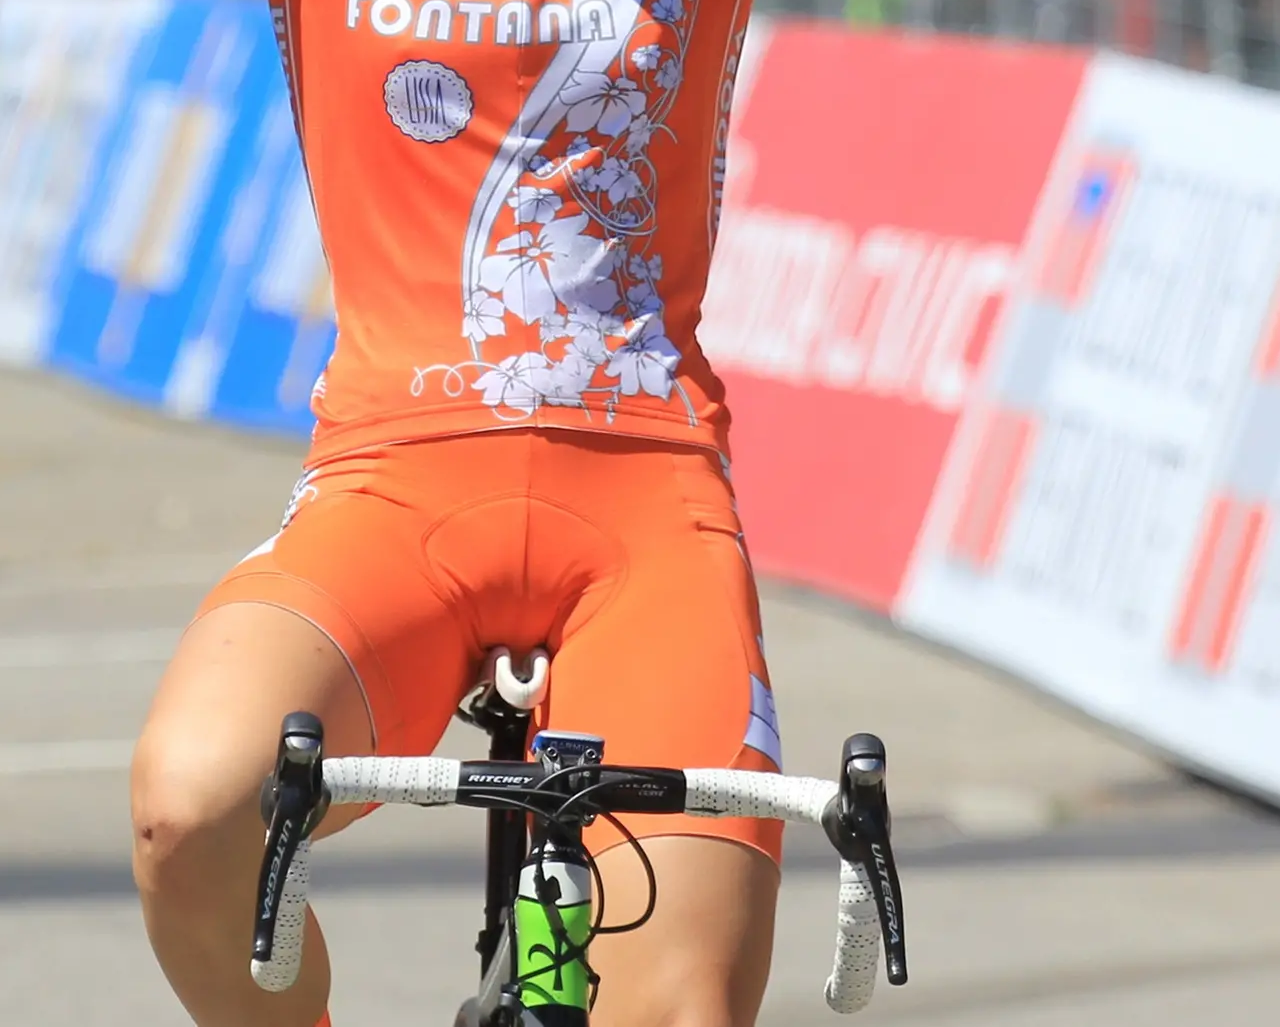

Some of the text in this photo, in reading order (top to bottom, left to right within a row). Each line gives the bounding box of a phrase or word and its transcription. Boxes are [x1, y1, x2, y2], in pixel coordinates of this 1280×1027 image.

[467, 774, 534, 784] RITCHEY
[261, 818, 293, 920] ULTEGRA
[870, 842, 901, 945] ULTEGRA
